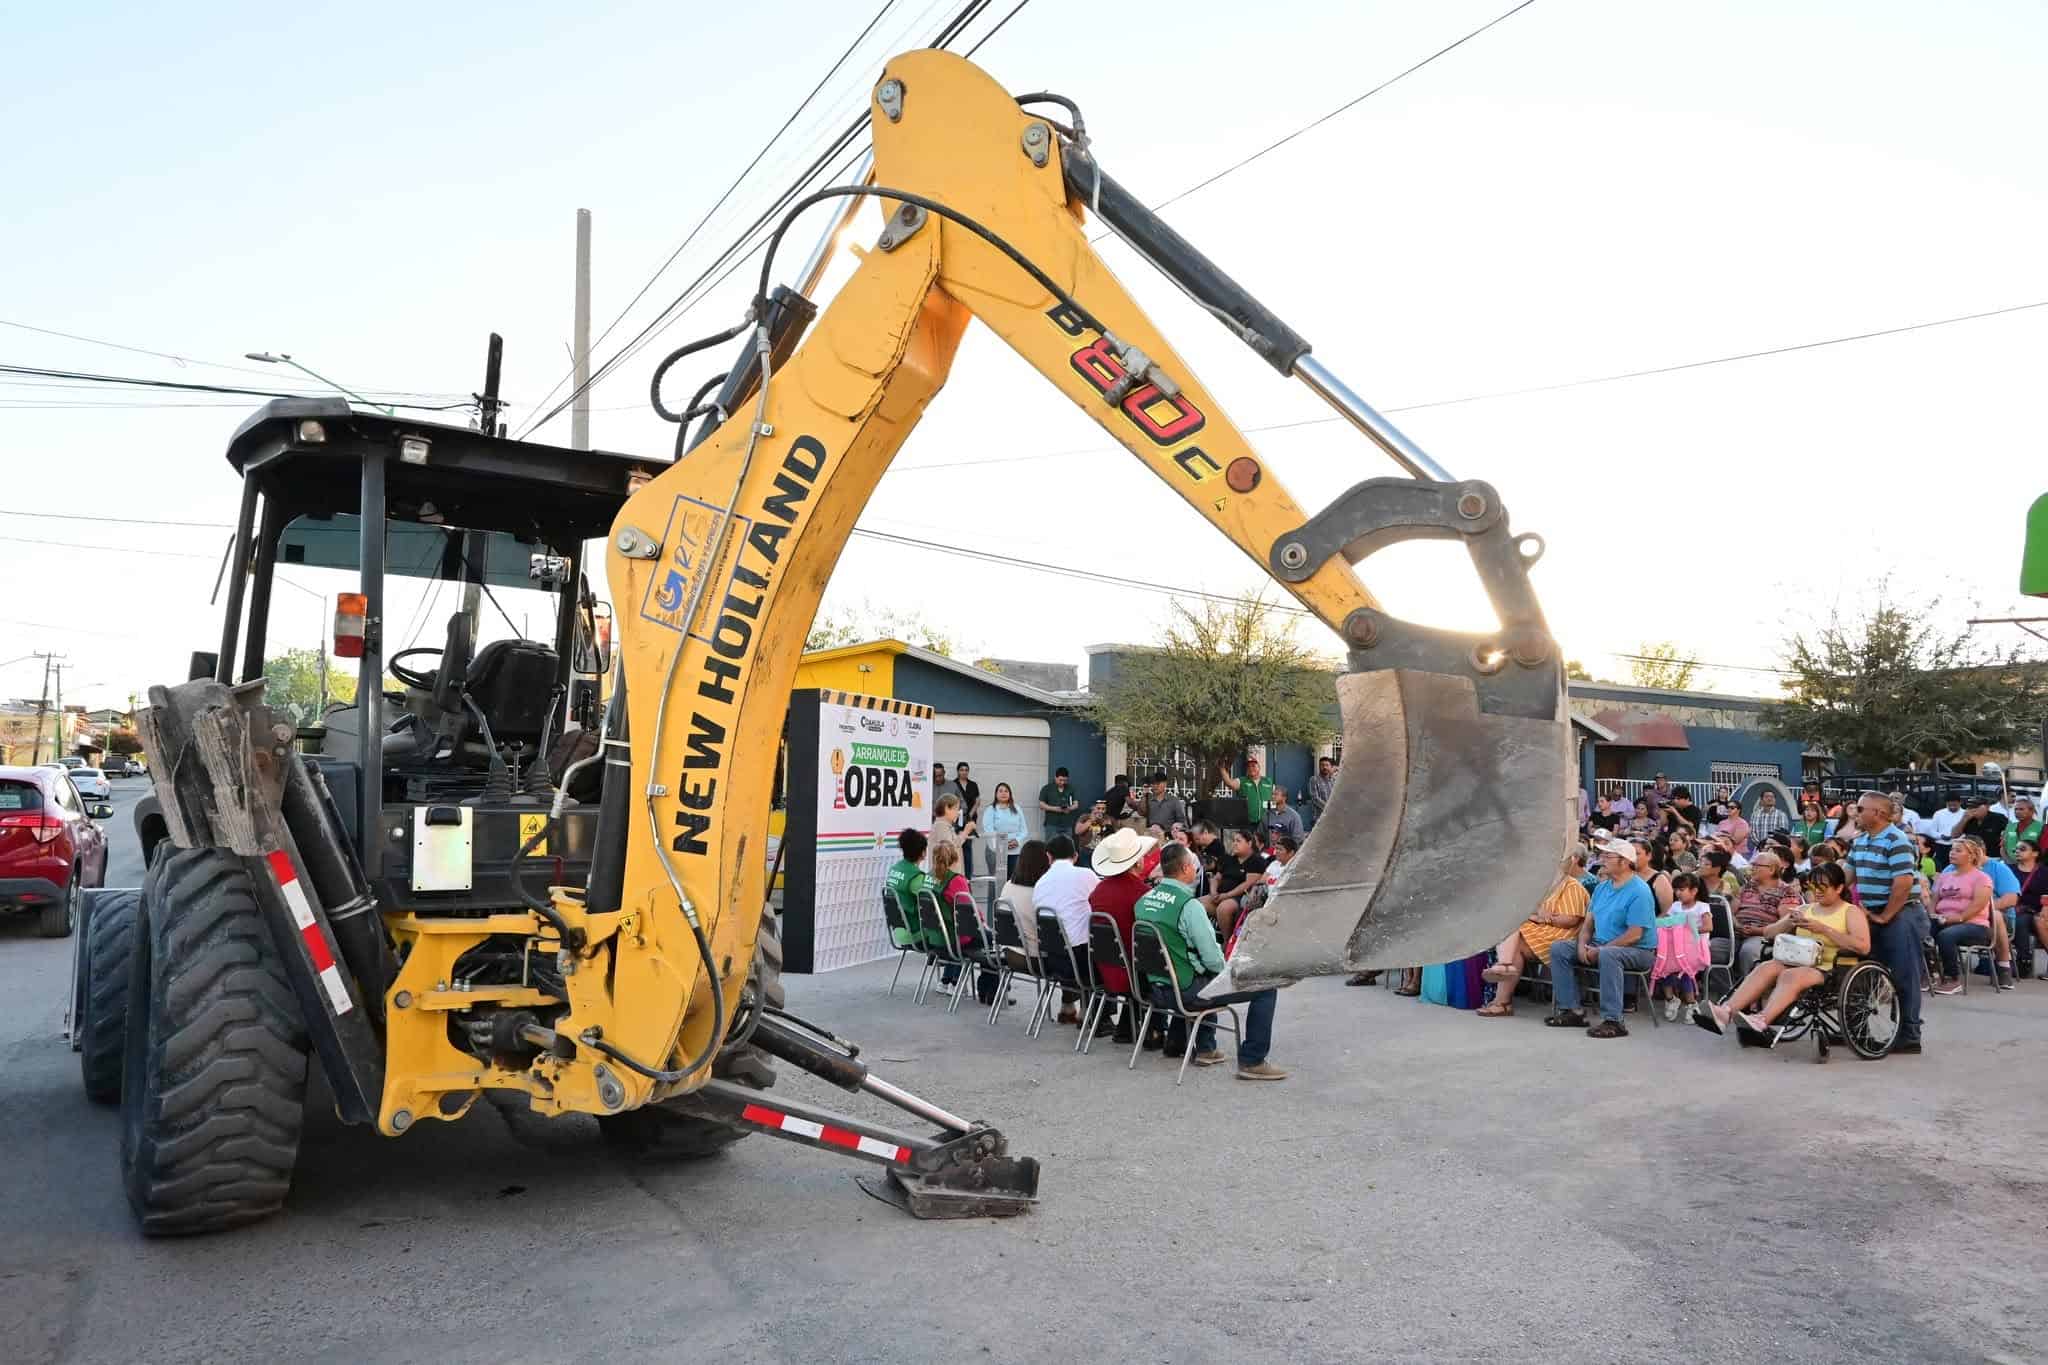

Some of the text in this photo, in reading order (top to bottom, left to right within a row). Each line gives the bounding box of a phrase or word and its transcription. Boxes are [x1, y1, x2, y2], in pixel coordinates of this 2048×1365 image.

[698, 434, 827, 705] HOLLAND
[673, 712, 727, 856] NEW
[845, 766, 912, 807] OBRA
[855, 746, 907, 763] ARRANQUE DE
